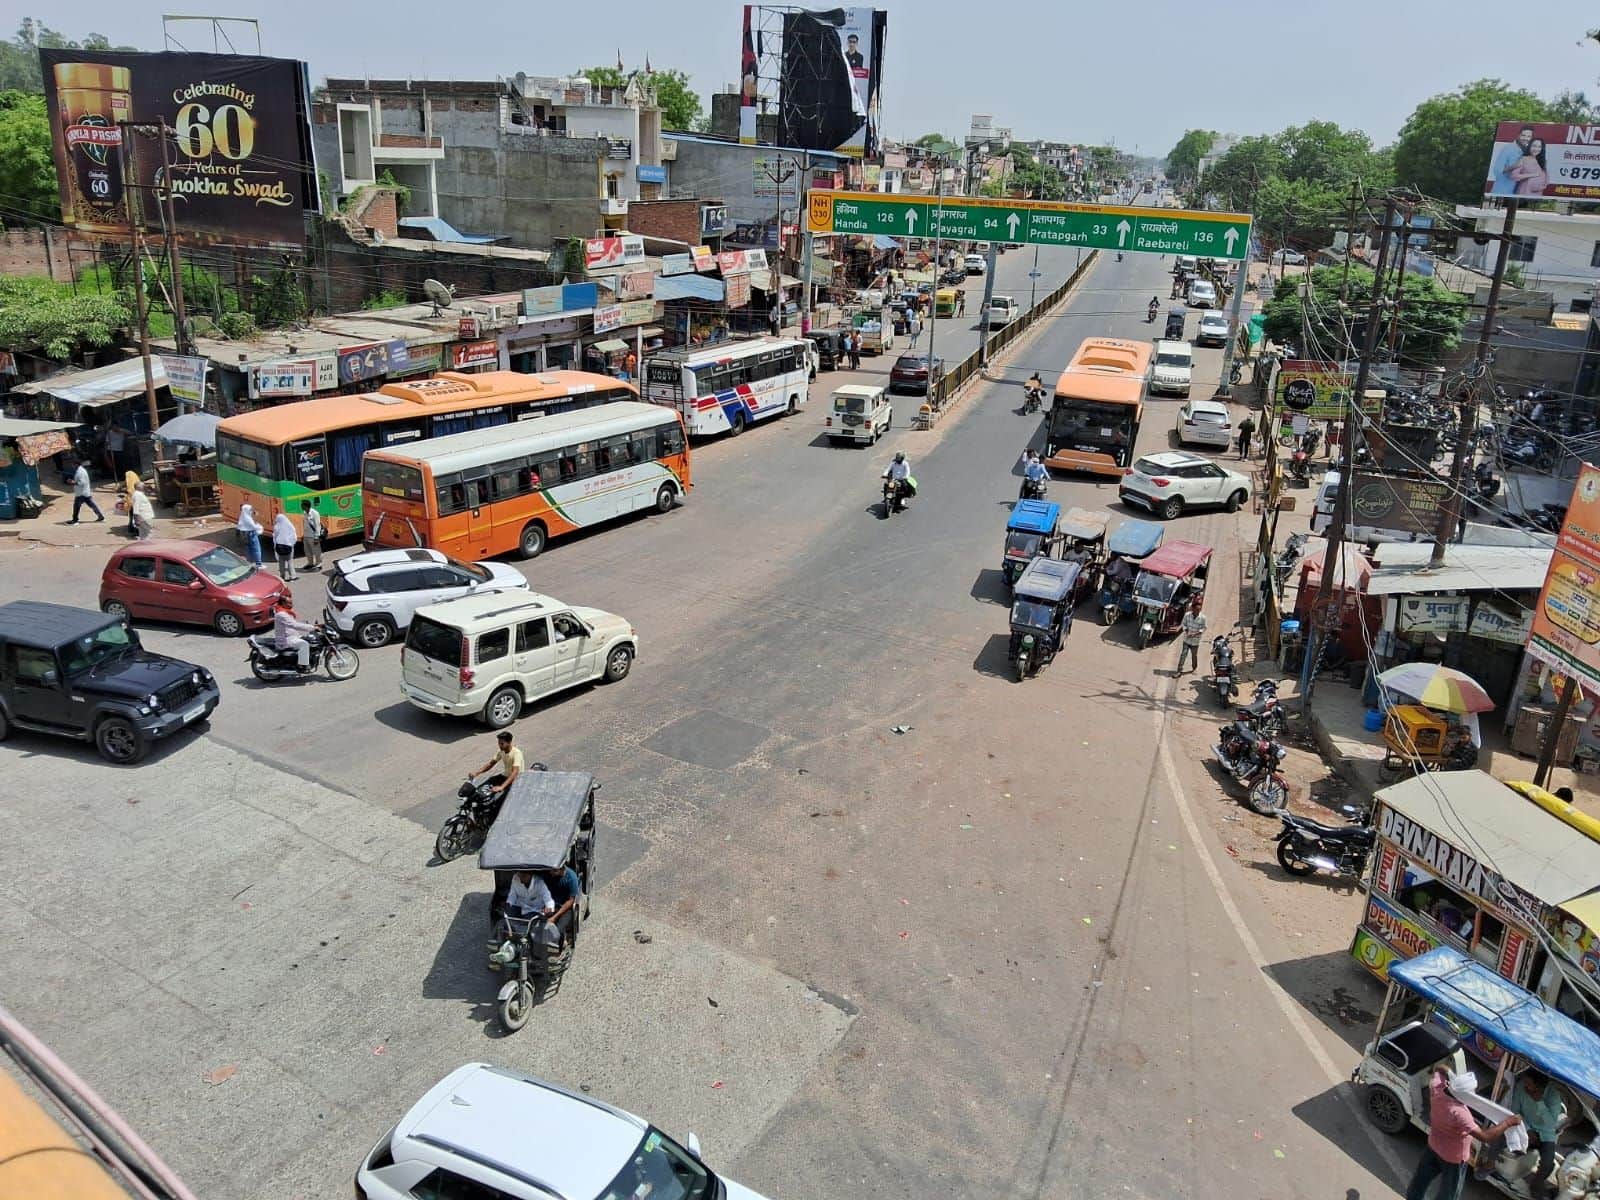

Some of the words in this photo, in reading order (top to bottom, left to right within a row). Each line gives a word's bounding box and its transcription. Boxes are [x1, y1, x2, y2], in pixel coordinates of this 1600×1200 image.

[173, 81, 255, 110] Celebrating
[91, 129, 122, 141] PASAN
[176, 103, 254, 160] 60
[194, 162, 226, 175] Years
[228, 164, 242, 175] of
[91, 180, 109, 195] 60
[233, 178, 293, 206] Swad
[814, 198, 828, 208] NH
[836, 202, 859, 216] हंडिया
[877, 212, 894, 223] 126
[983, 218, 999, 229] 94
[835, 218, 868, 231] Handia
[930, 223, 977, 236] Payagraj
[1092, 225, 1107, 236] 33
[1140, 222, 1178, 236] रायबरेली
[1030, 228, 1088, 243] Pratapgarh
[1194, 231, 1214, 243] 136
[1137, 237, 1190, 251] Raebareli
